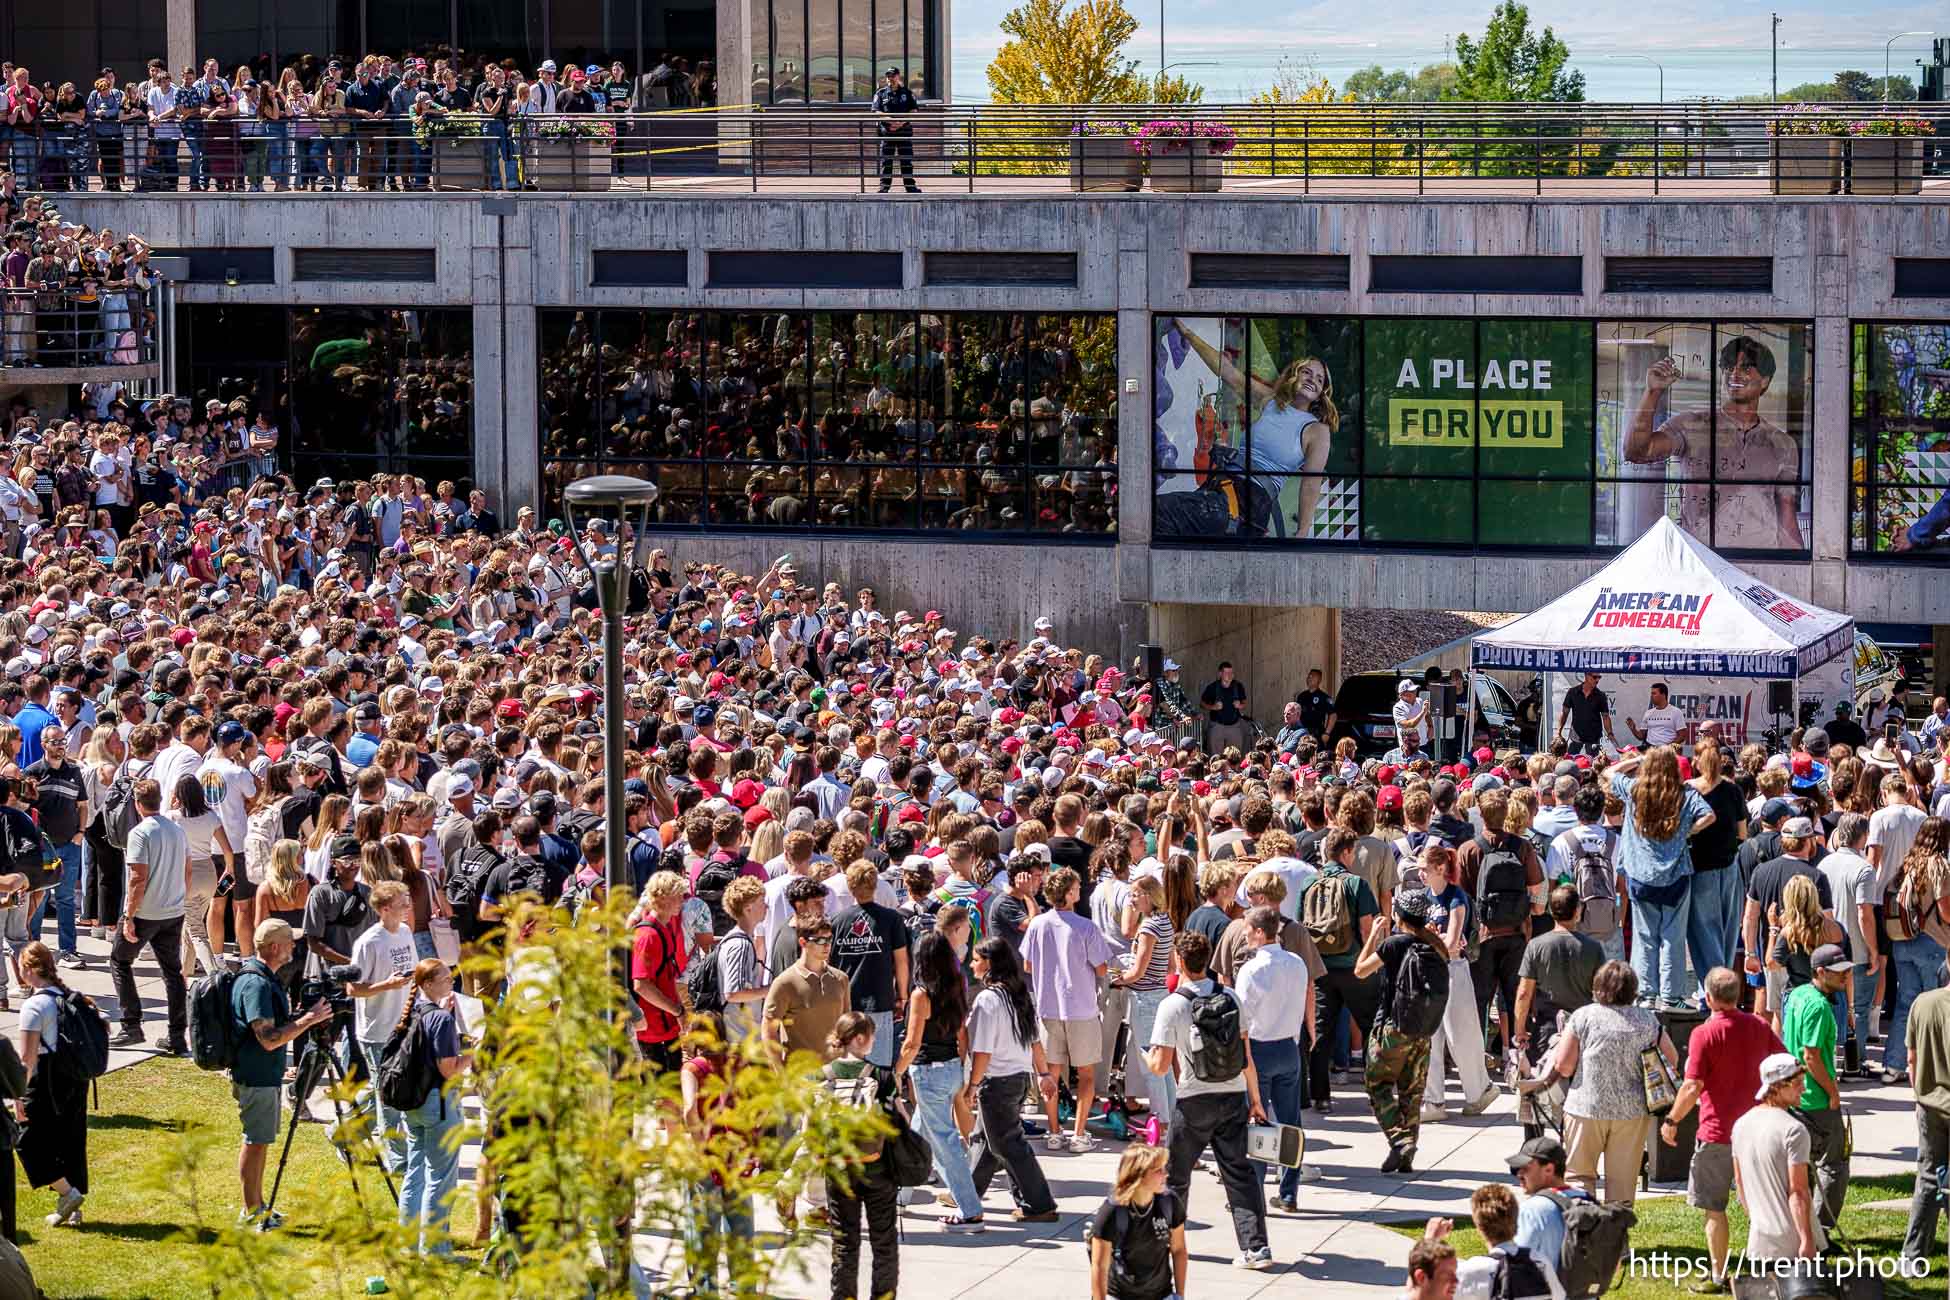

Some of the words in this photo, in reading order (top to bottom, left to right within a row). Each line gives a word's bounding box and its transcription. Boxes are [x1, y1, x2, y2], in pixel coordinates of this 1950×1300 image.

[1396, 358, 1420, 388] A
[1433, 359, 1552, 389] PLACE
[1401, 408, 1469, 438] FOR
[1484, 409, 1553, 439] YOU
[1593, 608, 1704, 629] COMEBACK
[1479, 646, 1533, 666] PROVE
[1536, 650, 1559, 667] ME
[1563, 650, 1624, 669] WRONG
[1641, 653, 1696, 671] PROVE
[1700, 654, 1723, 672] ME
[1727, 655, 1789, 673] WRONG
[836, 936, 883, 945] CALIFORNIA
